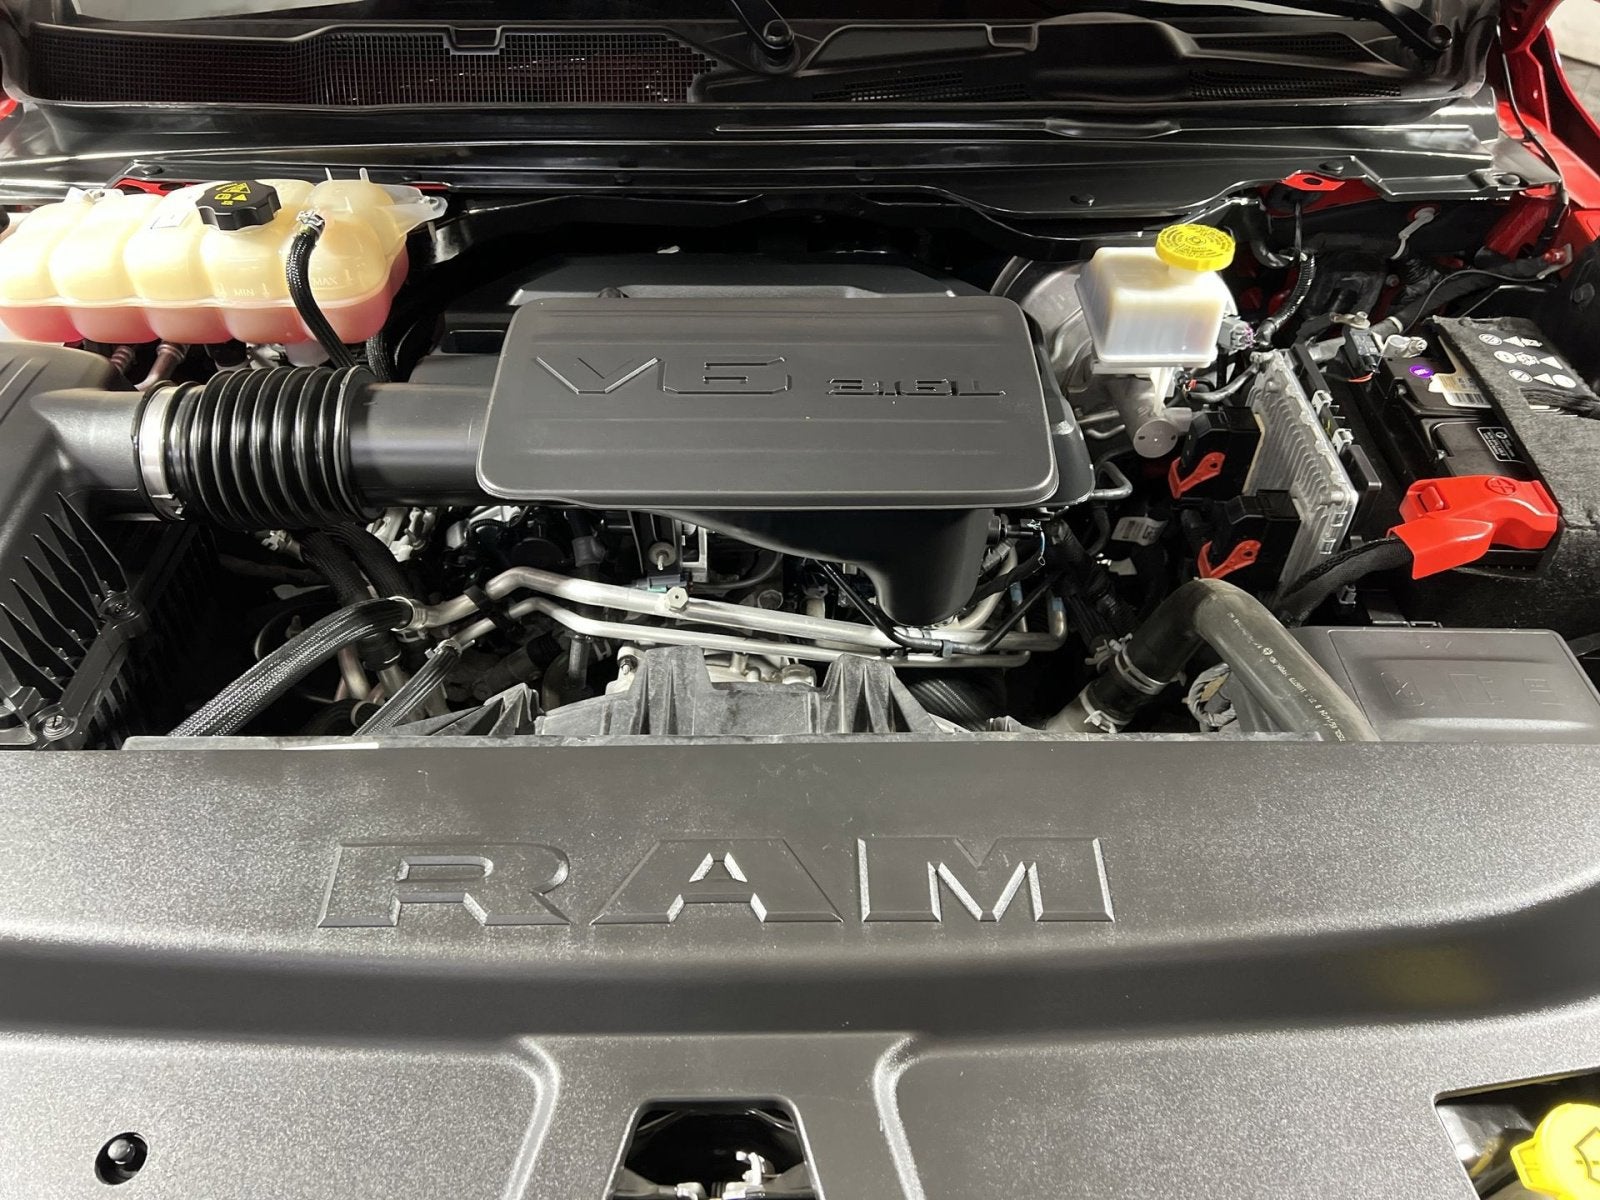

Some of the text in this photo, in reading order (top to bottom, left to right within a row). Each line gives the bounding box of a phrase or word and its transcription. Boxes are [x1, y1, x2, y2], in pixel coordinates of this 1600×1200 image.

[233, 287, 256, 297] MIN
[313, 276, 339, 287] MAX
[534, 355, 1007, 397] V6 3.6L
[317, 837, 1116, 927] RAM
